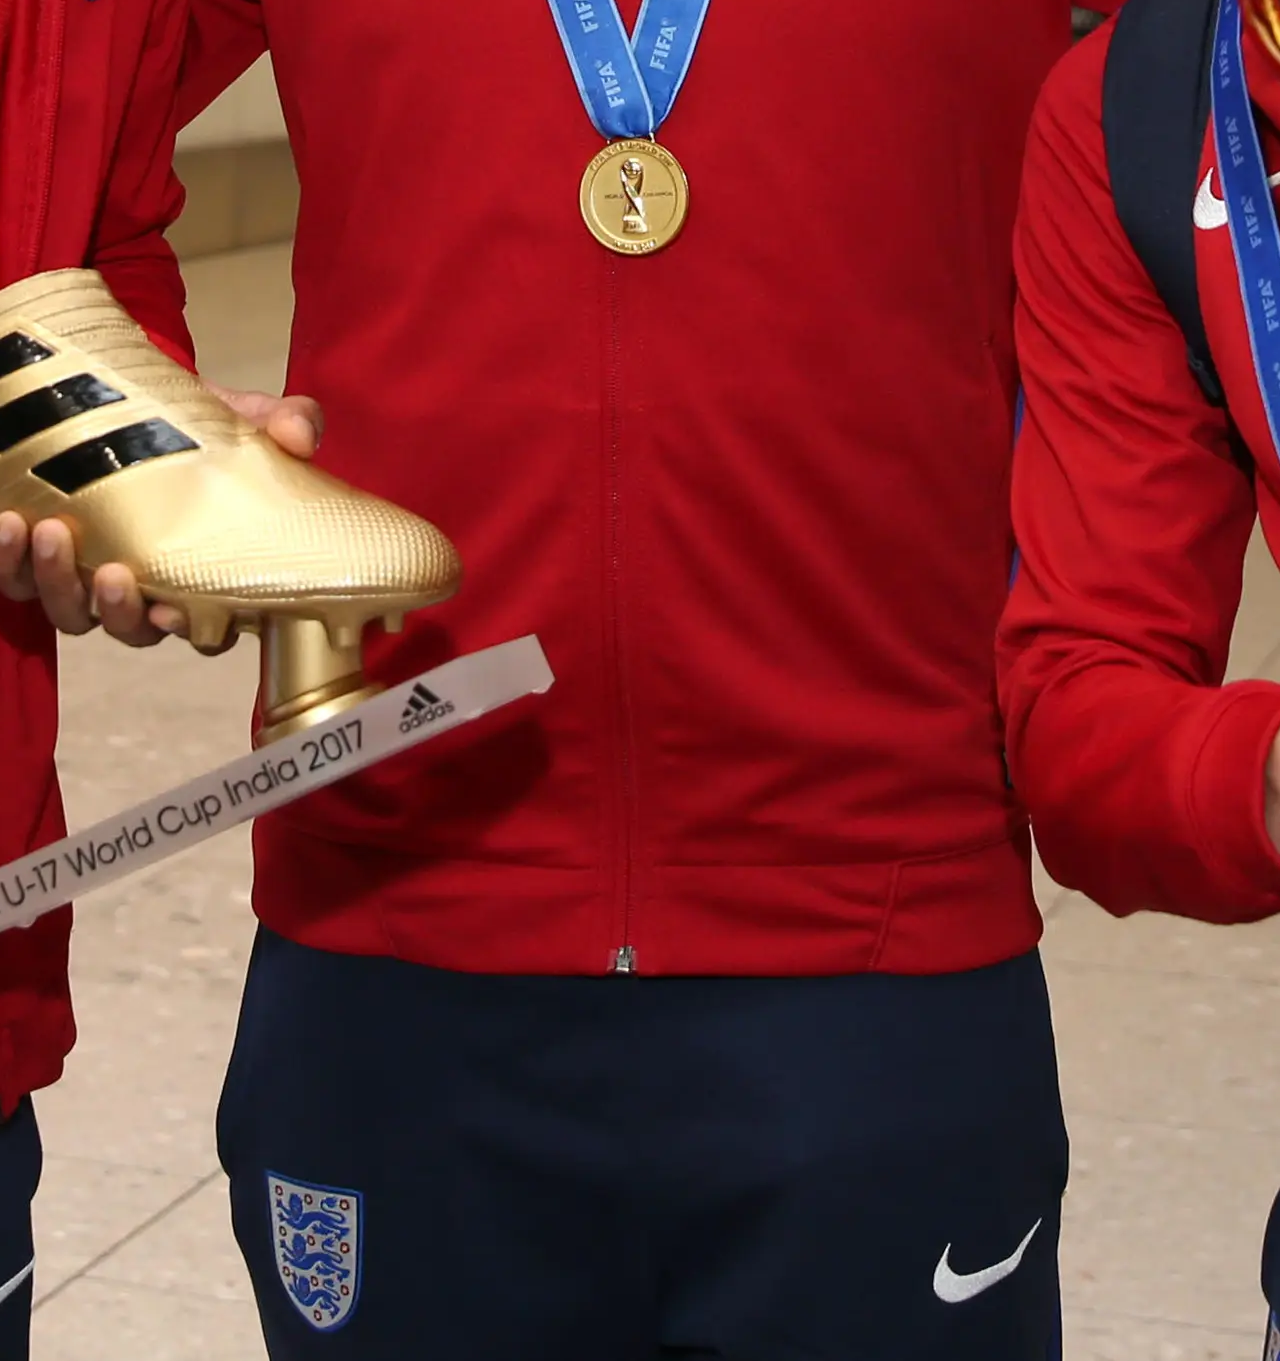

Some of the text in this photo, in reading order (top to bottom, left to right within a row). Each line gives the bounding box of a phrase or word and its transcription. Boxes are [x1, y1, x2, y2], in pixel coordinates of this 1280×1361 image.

[398, 697, 456, 734] adidas
[0, 863, 61, 910] U-17
[62, 817, 153, 878] World
[156, 792, 222, 838] Cup
[222, 759, 301, 807] India
[300, 718, 366, 774] 2017
